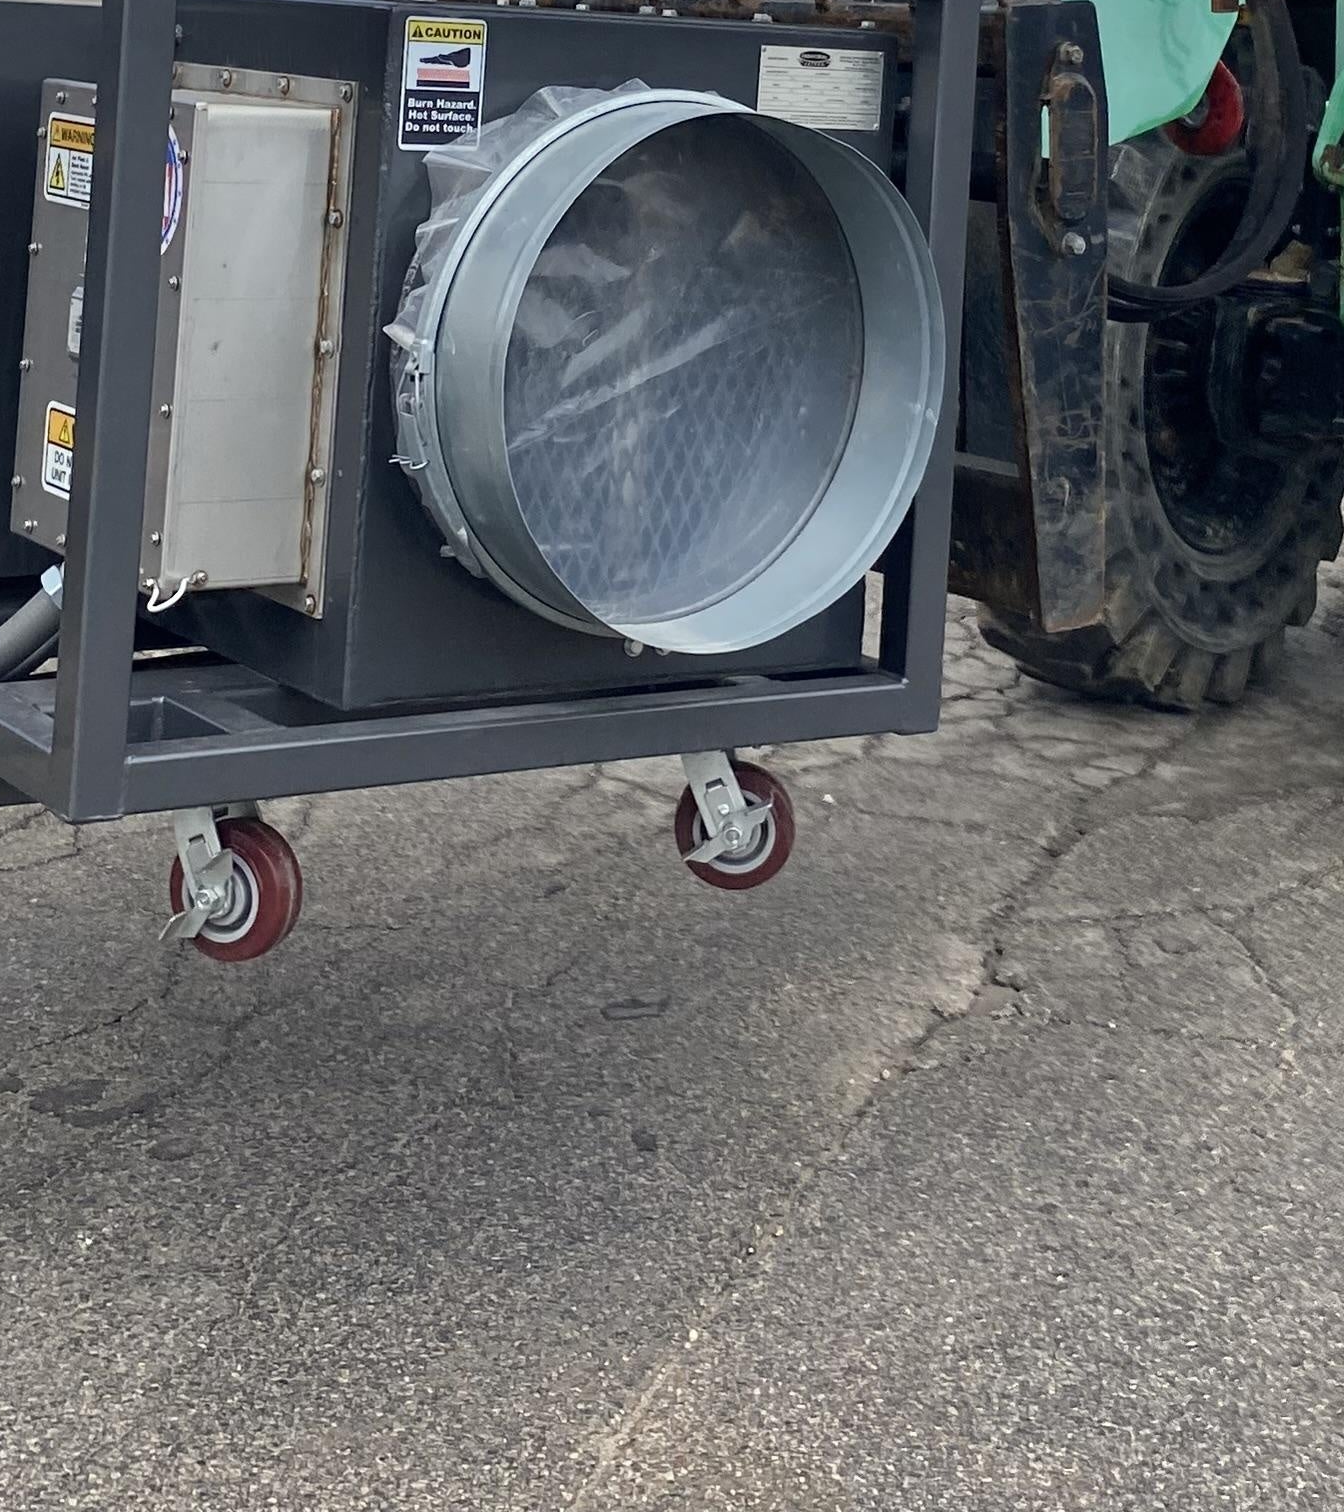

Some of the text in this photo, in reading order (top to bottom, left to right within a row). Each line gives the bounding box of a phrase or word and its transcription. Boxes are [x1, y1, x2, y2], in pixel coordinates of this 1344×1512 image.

[425, 27, 481, 40] CAUTION
[408, 98, 477, 110] Burn Hazard.
[408, 110, 475, 122] Hot Surface.
[405, 122, 420, 132] Do
[422, 123, 440, 133] not
[54, 451, 65, 463] DO
